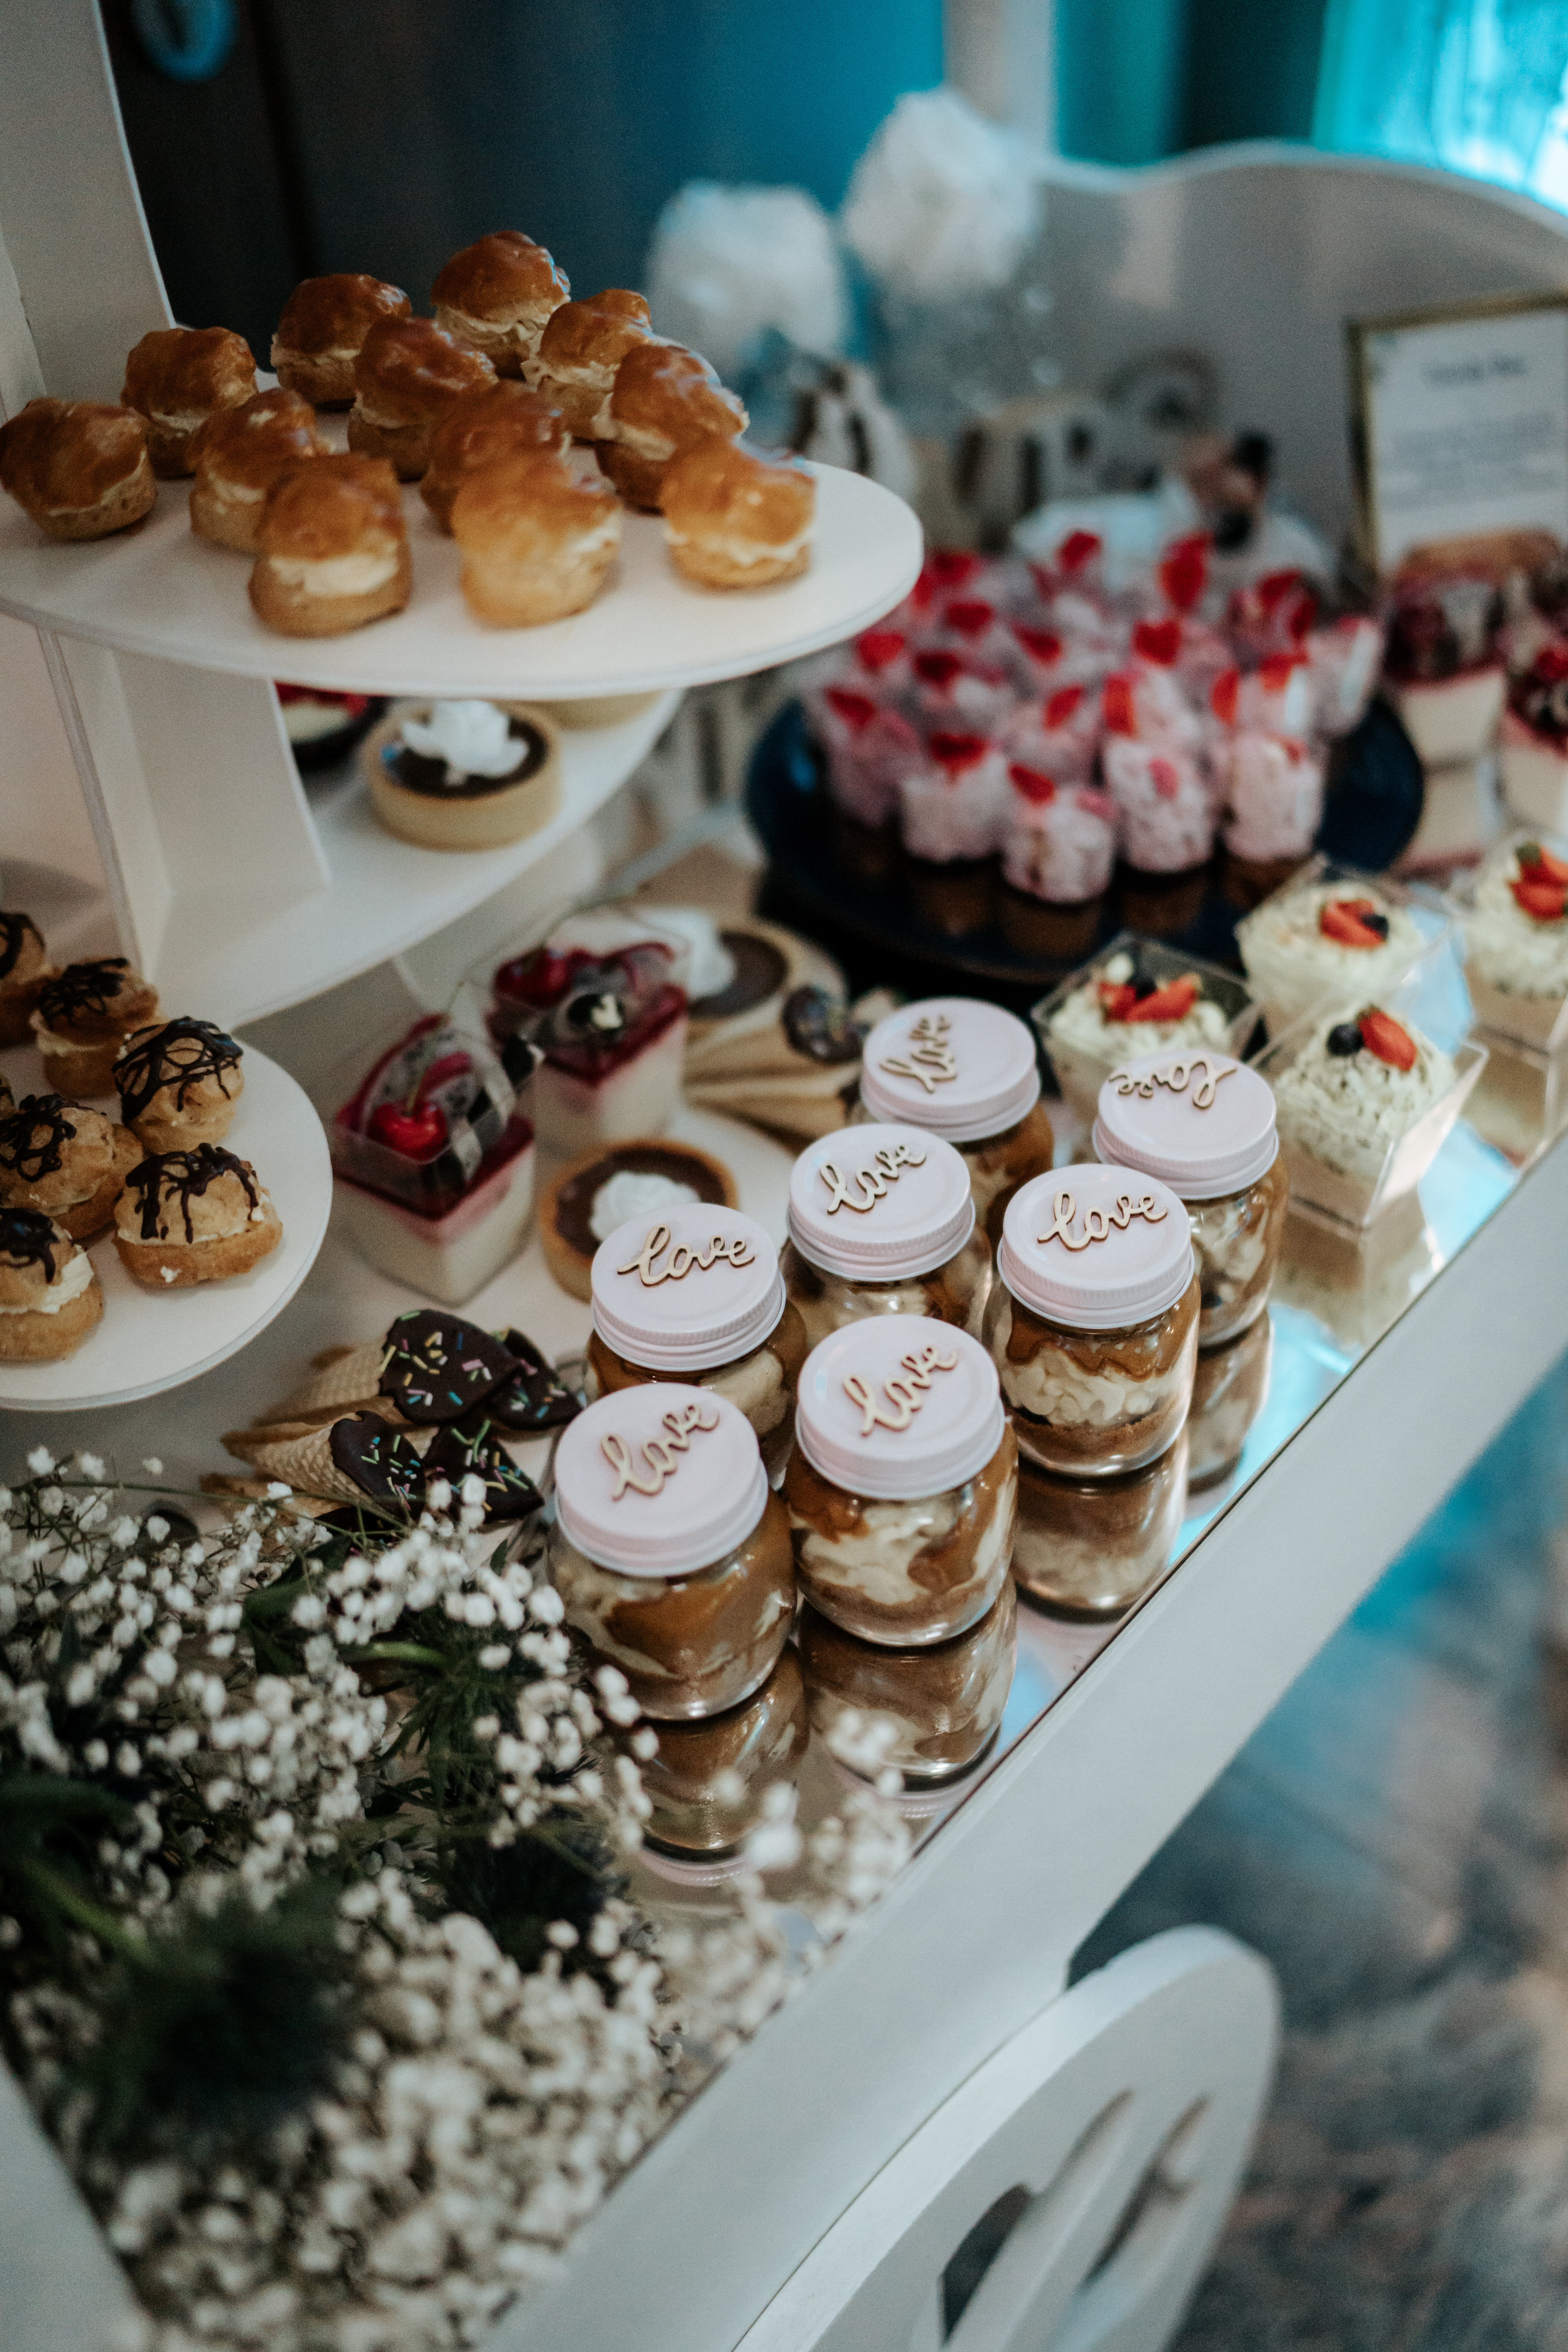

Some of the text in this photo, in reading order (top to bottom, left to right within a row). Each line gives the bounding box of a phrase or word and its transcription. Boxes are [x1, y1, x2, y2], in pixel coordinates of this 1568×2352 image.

[1109, 1056, 1237, 1109] love
[819, 1145, 926, 1215] love
[617, 1223, 755, 1287] love
[1037, 1191, 1167, 1252] love
[843, 1346, 957, 1437] love
[601, 1404, 719, 1502] love
